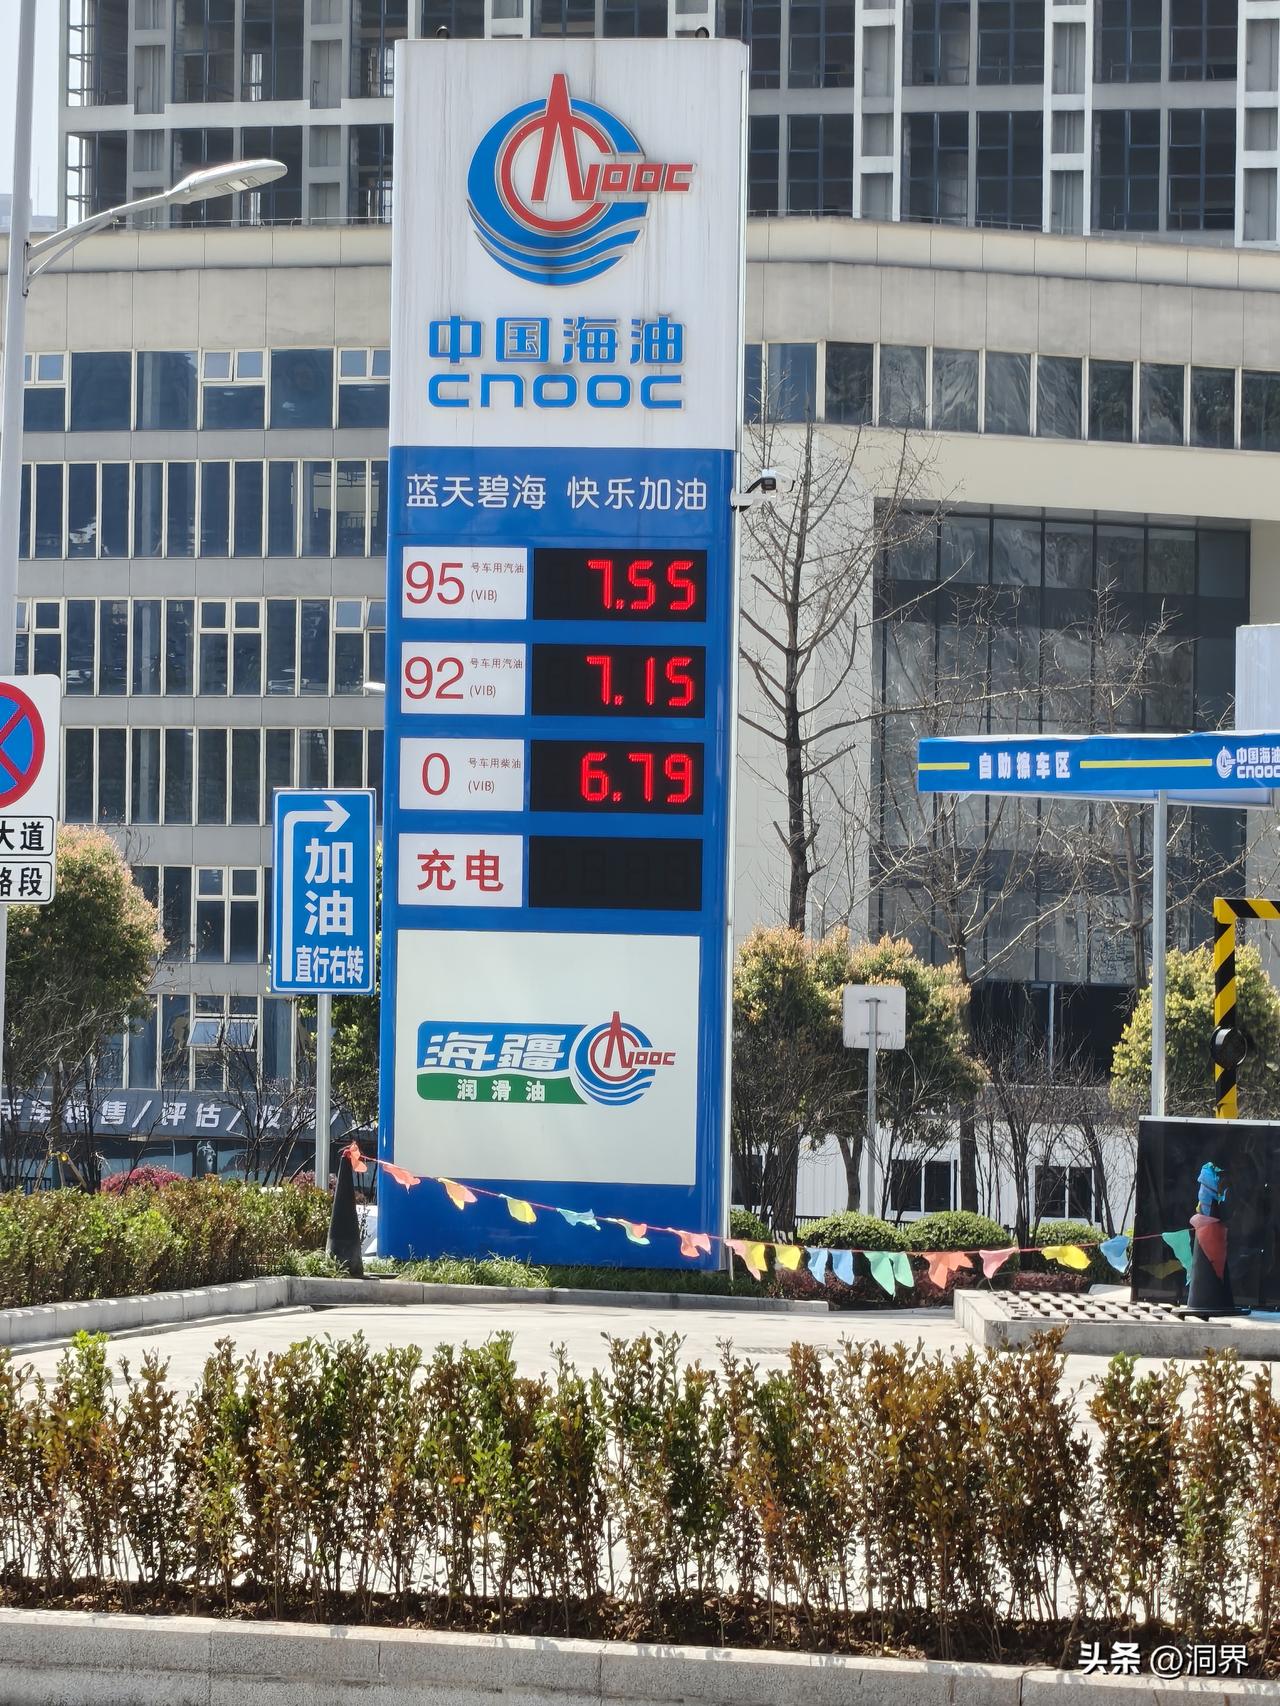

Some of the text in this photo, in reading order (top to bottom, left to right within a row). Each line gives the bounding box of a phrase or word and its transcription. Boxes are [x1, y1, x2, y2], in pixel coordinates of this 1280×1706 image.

[428, 315, 685, 366] 中国海油
[406, 473, 707, 512] 蓝天碧海 快乐加油
[405, 560, 465, 605] 95
[470, 562, 525, 574] 号车用汽油
[586, 559, 697, 610] 7.55
[470, 588, 498, 604] (VIB)
[404, 656, 465, 700] 92
[469, 657, 523, 670] 号车用汽油
[586, 655, 695, 706] 7.15
[469, 684, 497, 699] (VIB)
[421, 752, 451, 796] 0
[468, 757, 522, 769] 号车用柴油
[579, 751, 693, 803] 6.79
[467, 779, 495, 795] (VIB)
[304, 838, 354, 936] 加油
[416, 848, 504, 893] 充电
[295, 945, 364, 985] 直行右转
[423, 1031, 567, 1072] 海疆
[456, 1078, 546, 1102] 润滑油
